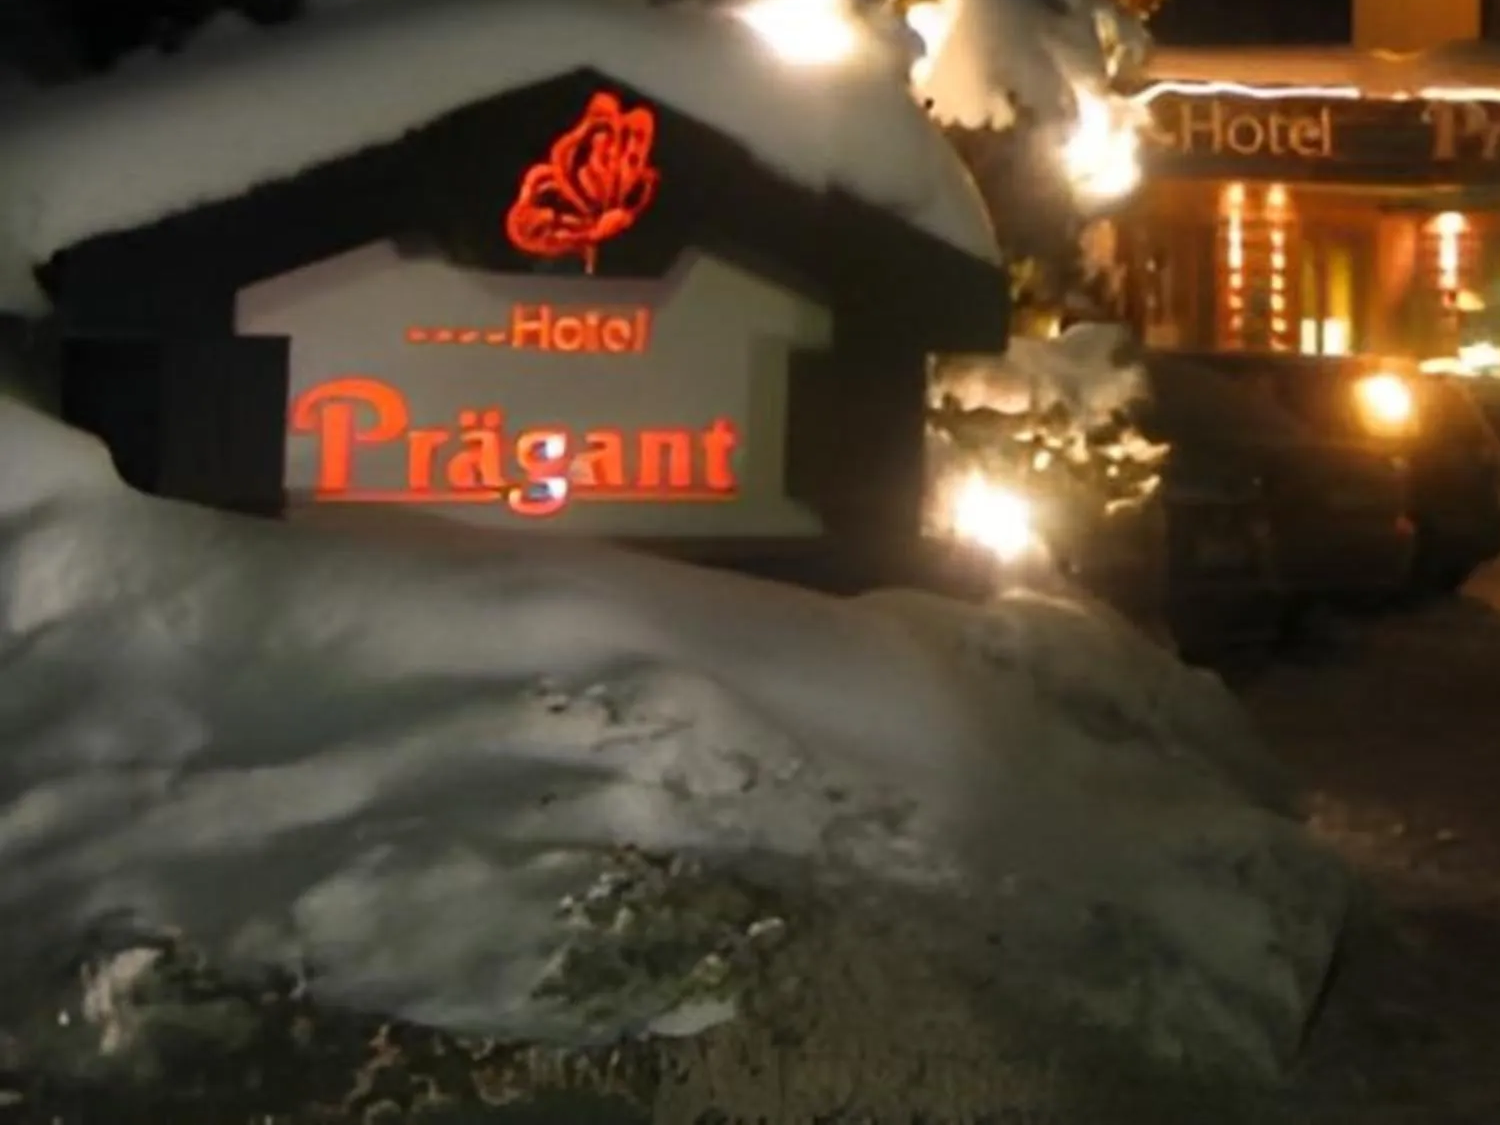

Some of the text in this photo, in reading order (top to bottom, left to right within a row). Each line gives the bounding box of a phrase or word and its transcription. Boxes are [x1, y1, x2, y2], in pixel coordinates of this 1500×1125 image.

[1181, 103, 1334, 157] Hotel
[511, 305, 652, 353] Hotel
[293, 376, 738, 515] Prägant
